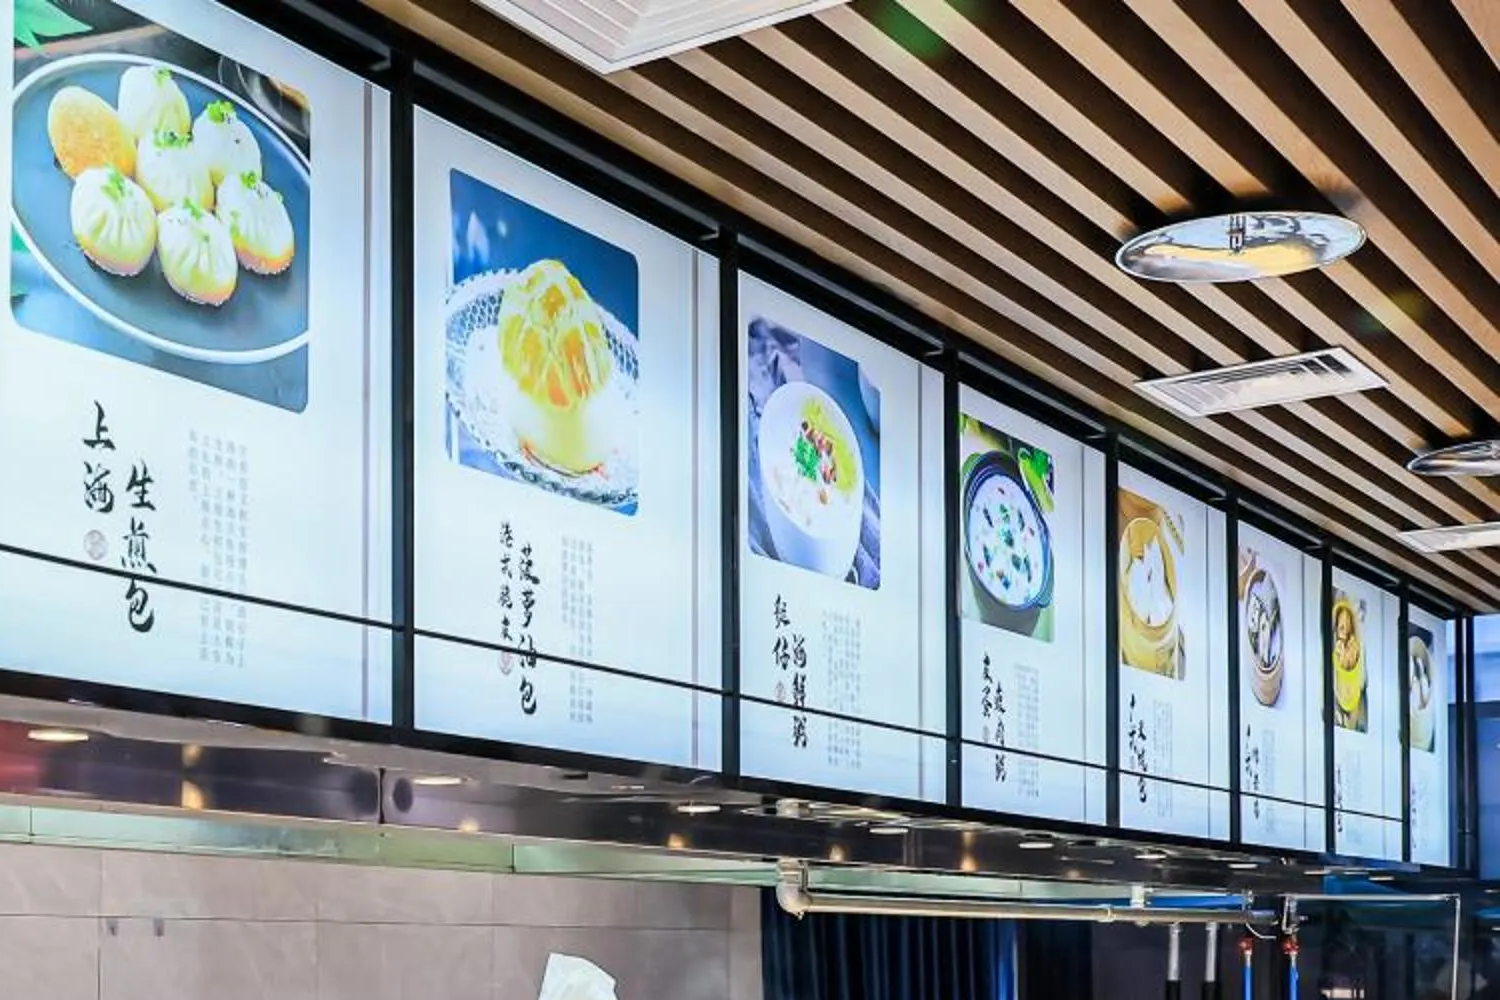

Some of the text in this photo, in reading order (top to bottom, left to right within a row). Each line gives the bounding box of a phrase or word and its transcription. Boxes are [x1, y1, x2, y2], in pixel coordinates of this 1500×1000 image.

[82, 399, 117, 514] 上海
[121, 459, 157, 634] 生煎包
[792, 633, 808, 749] 海鲜粥
